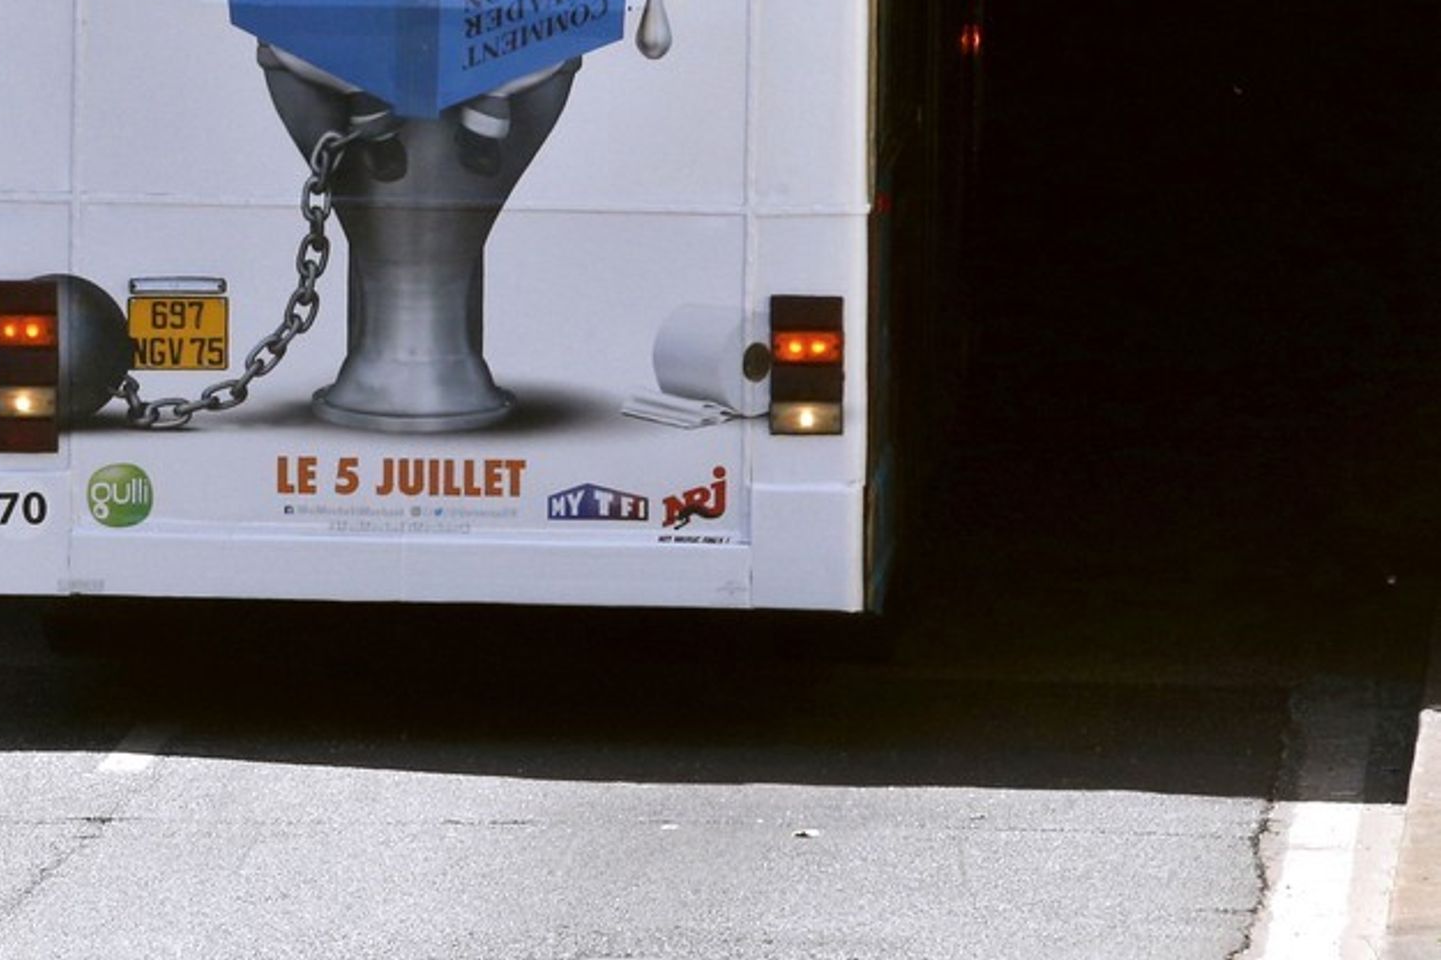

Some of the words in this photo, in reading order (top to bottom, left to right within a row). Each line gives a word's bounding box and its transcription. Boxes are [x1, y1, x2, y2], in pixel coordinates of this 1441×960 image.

[151, 301, 205, 330] 697
[130, 337, 184, 366] NGV
[189, 337, 224, 366] 75
[276, 456, 318, 495] LE
[335, 457, 360, 496] 5
[376, 458, 527, 498] JUILLET
[90, 478, 150, 520] gulli
